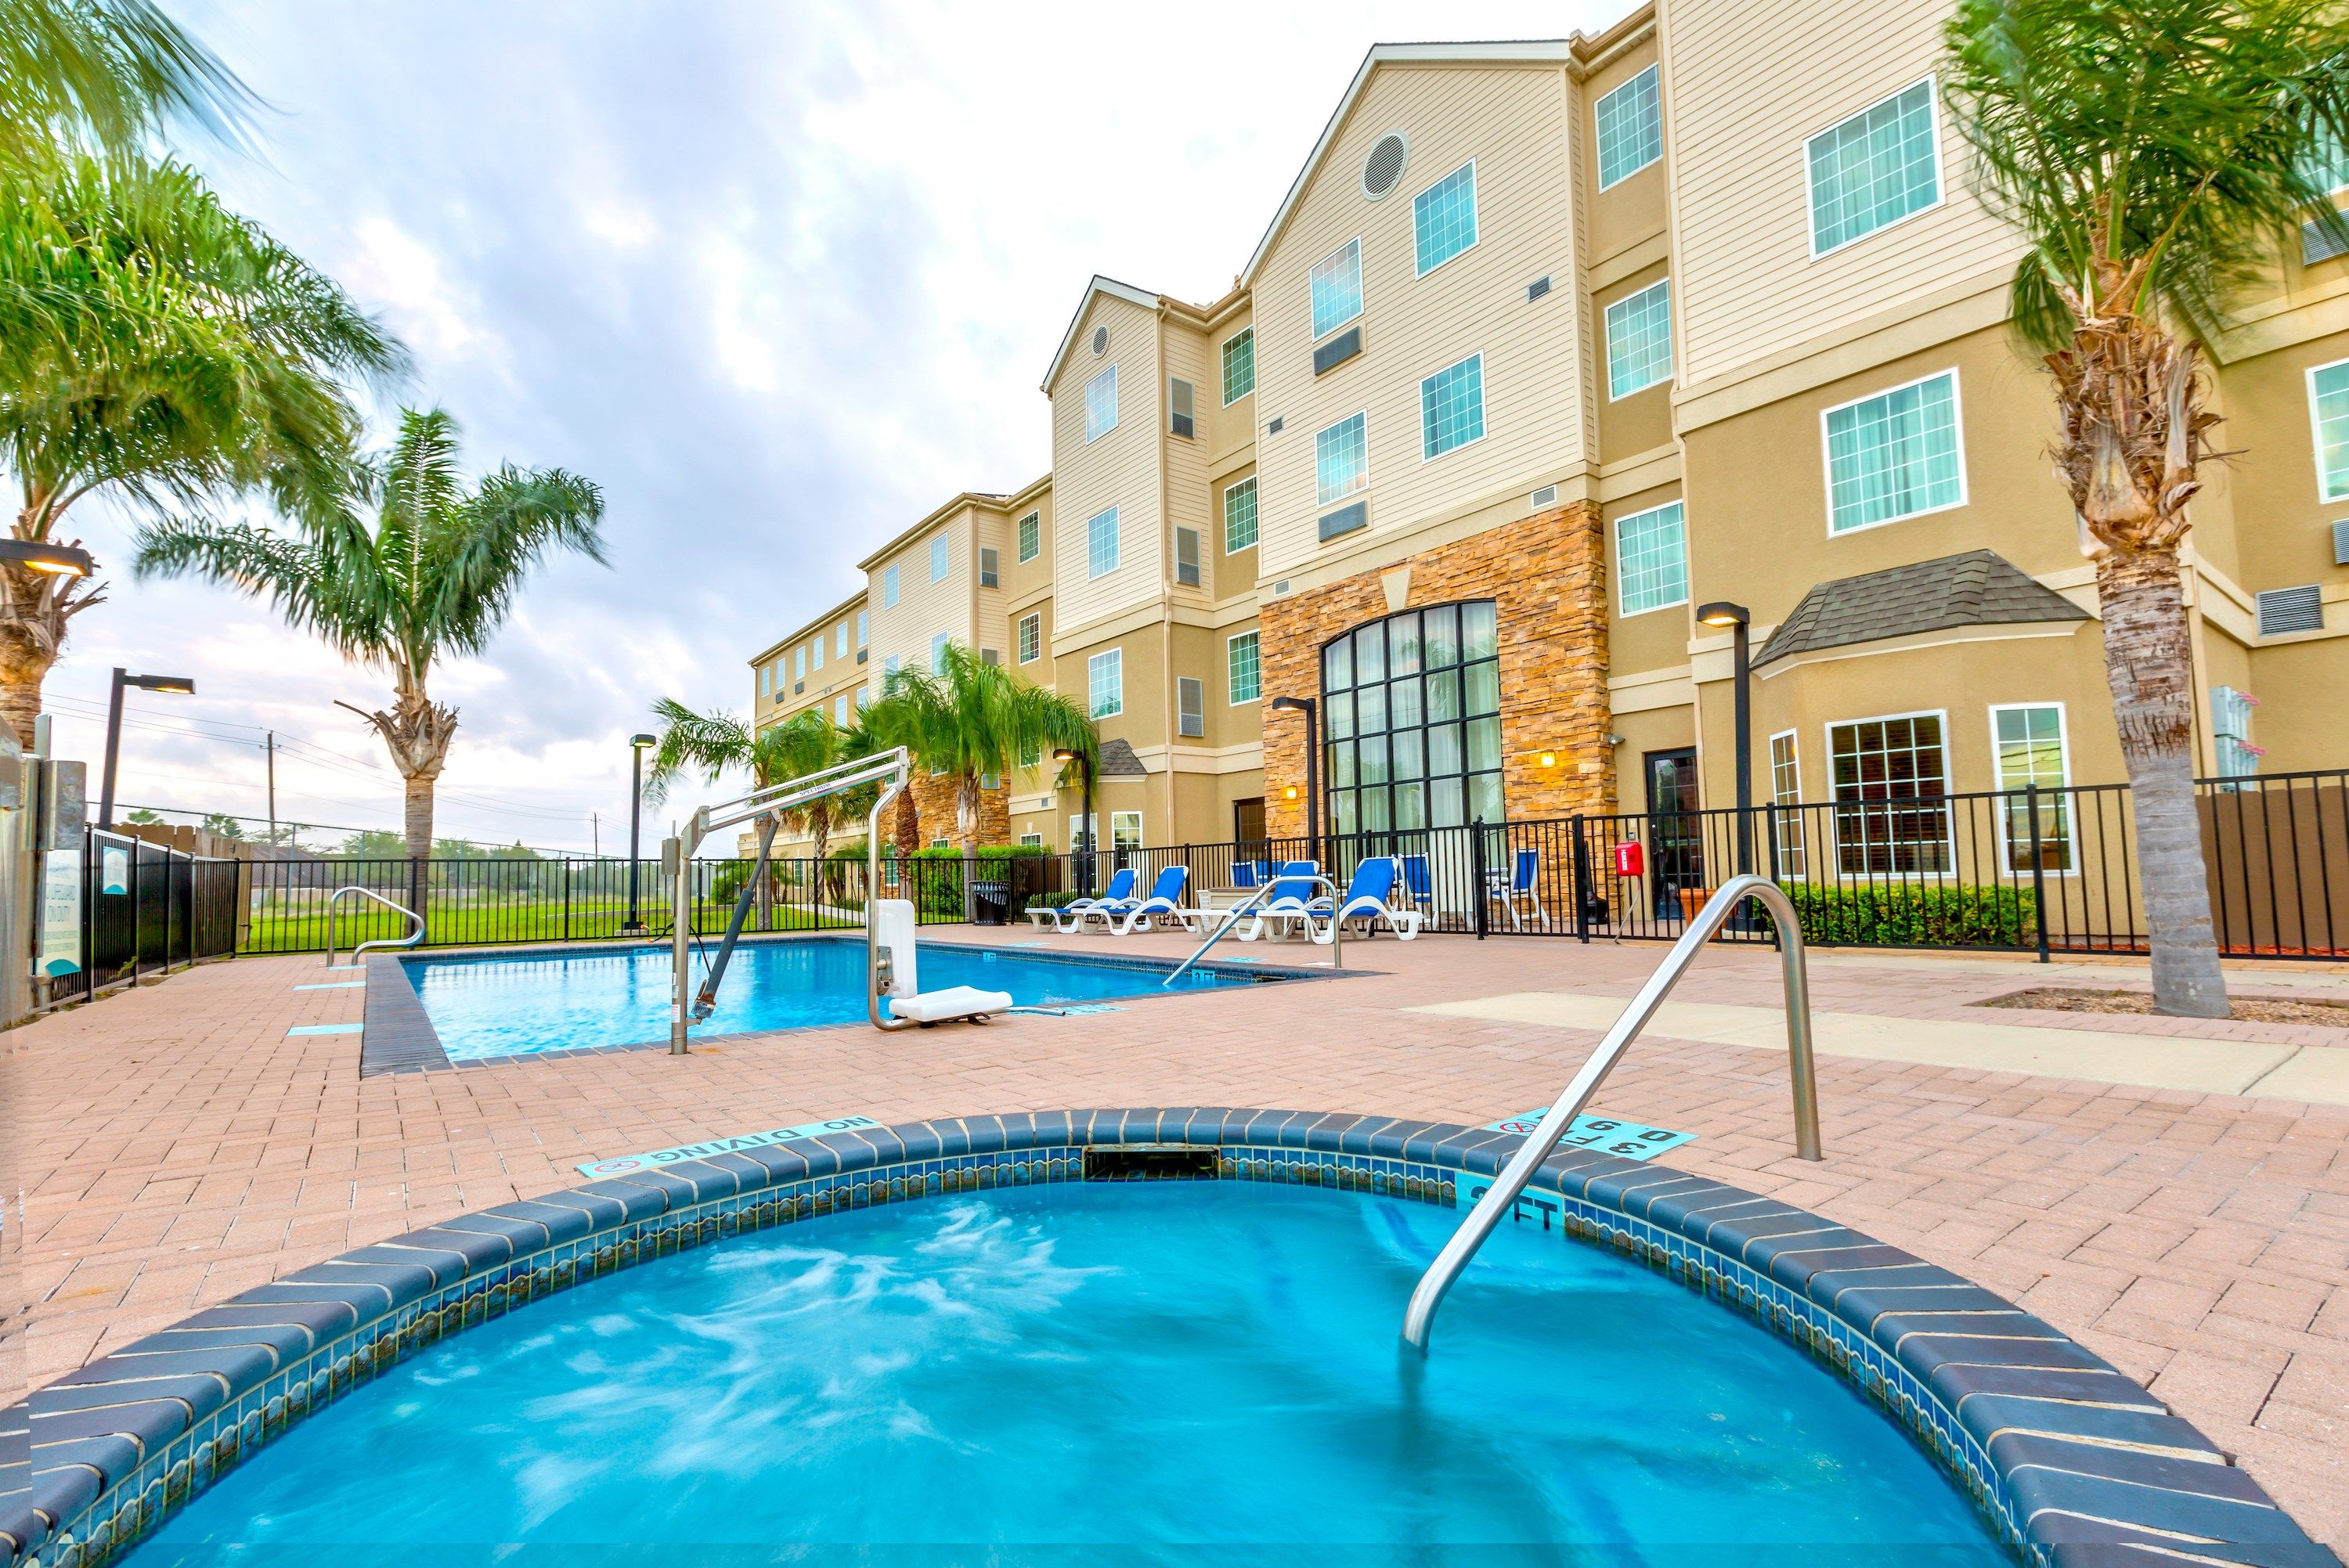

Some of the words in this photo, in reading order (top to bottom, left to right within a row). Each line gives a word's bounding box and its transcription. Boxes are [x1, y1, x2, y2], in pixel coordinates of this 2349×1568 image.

[799, 783, 831, 796] SPECTRUM
[823, 1116, 874, 1130] NO
[1561, 1130, 1605, 1145] F
[651, 1130, 801, 1162] DIVING
[1608, 1142, 1647, 1154] 3
